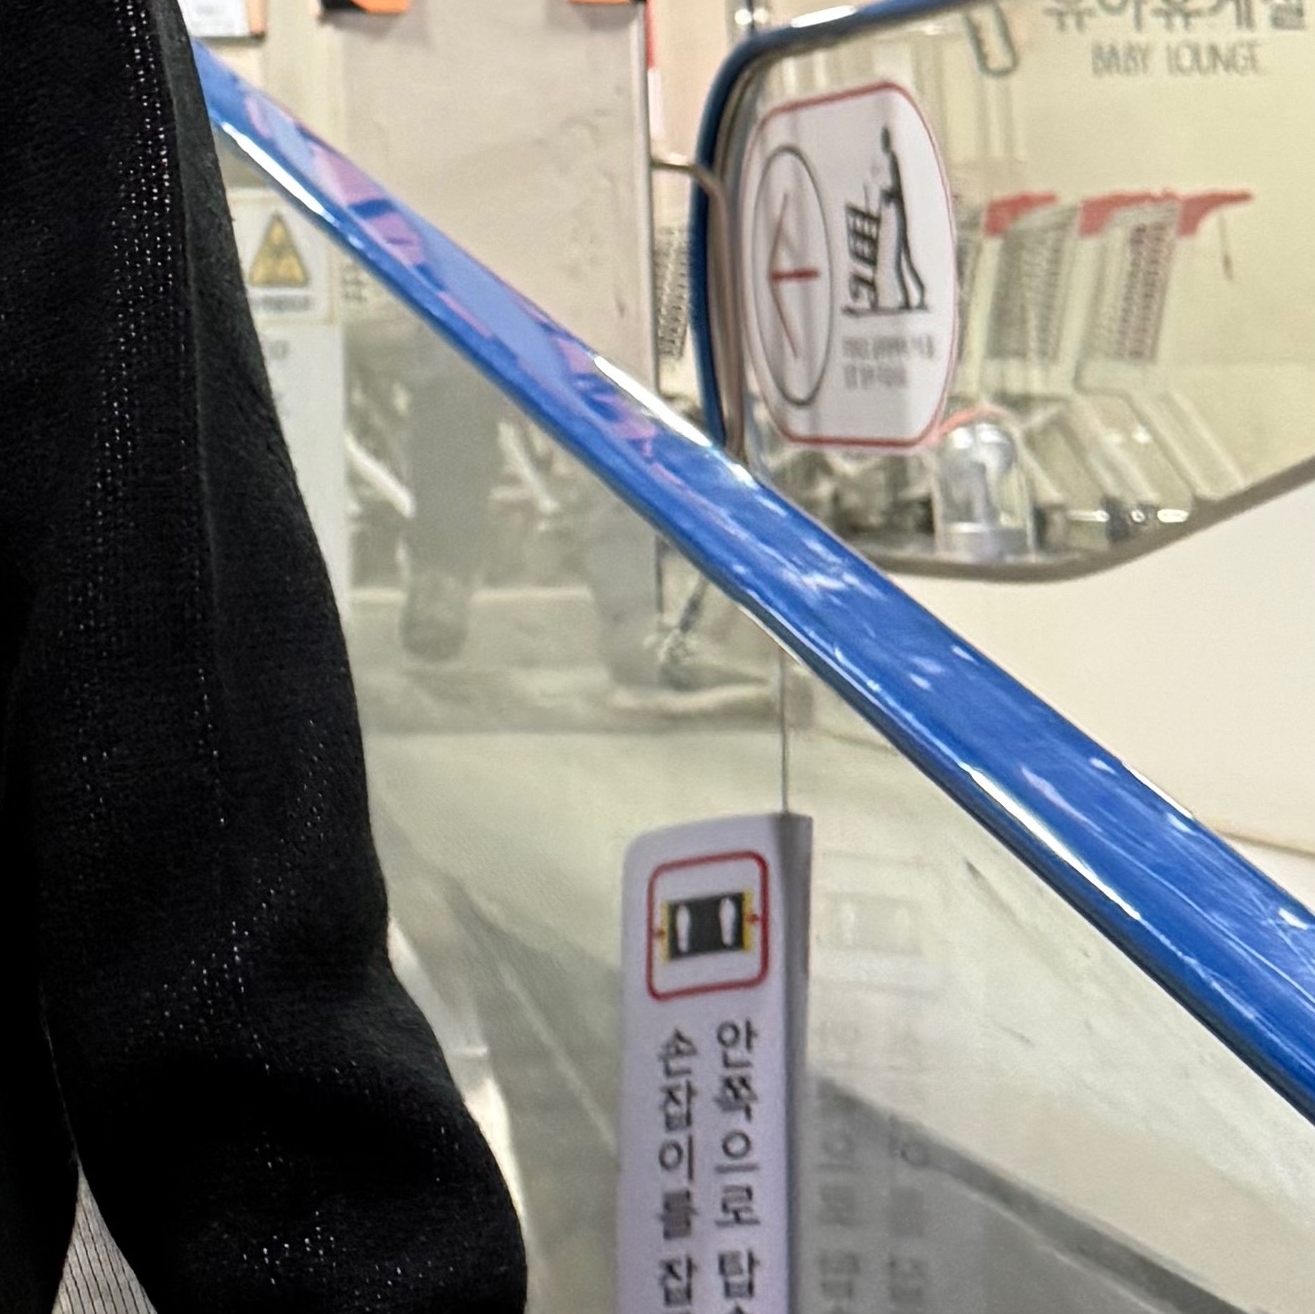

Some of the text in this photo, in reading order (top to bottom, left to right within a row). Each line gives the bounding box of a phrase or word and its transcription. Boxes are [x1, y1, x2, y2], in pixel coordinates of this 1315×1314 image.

[1091, 38, 1260, 76] BABY LOUNGE
[658, 1028, 698, 1240] 손잡이를
[715, 1017, 761, 1227] 안쪽으로
